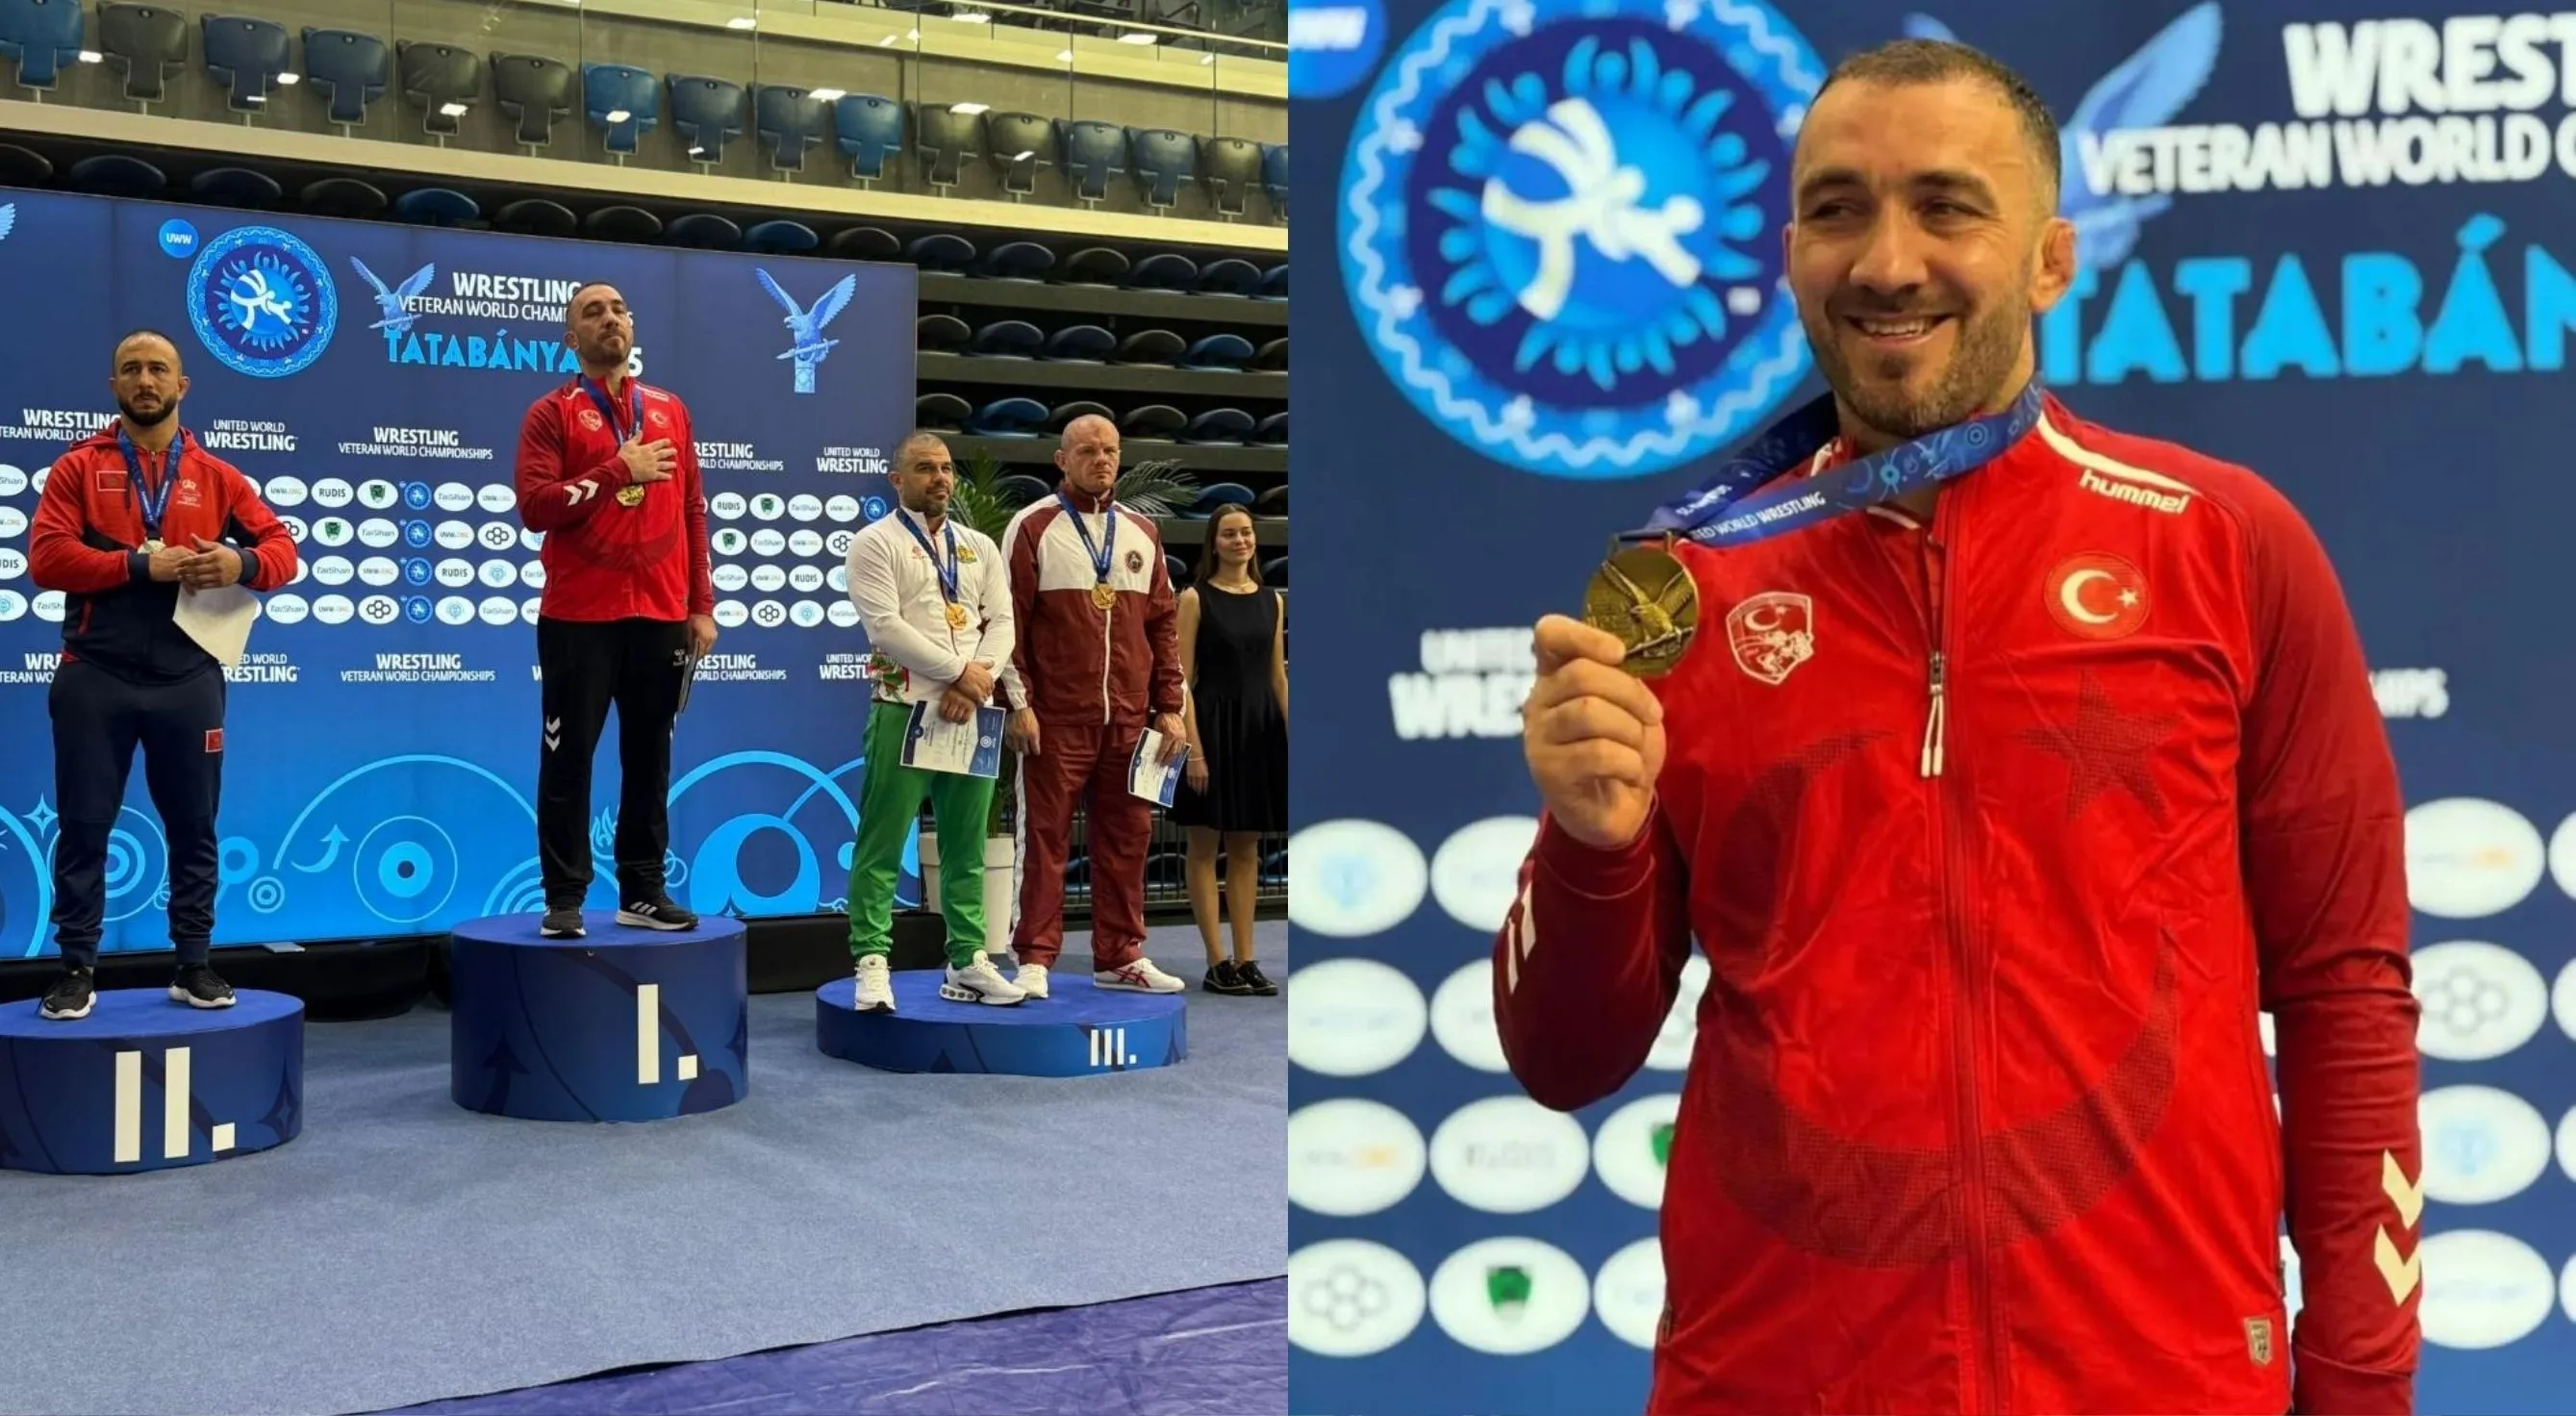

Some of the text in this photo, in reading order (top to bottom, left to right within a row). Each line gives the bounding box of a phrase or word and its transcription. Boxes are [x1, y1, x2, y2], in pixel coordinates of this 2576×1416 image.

[2078, 119, 2332, 195] VETERAN
[2334, 114, 2552, 188] WORLD
[166, 232, 192, 245] UWW
[398, 294, 568, 323] VETERAN WORLD CHAM
[383, 328, 582, 374] TATABÁNYA
[33, 427, 74, 442] WORLD
[214, 418, 285, 434] UNITED WORLD
[204, 431, 295, 451] WRESTLING
[373, 426, 460, 446] WRESTLING
[338, 442, 493, 460] VETERAN WORLD CHAMPIONSHIPS
[694, 442, 754, 459] RESTLING
[823, 446, 880, 458] UNITED WORLD
[717, 458, 784, 471] CHAMPIONSHIPS
[816, 456, 888, 474] WRESTLING
[318, 487, 346, 497] RUDIS
[2079, 468, 2190, 515] hummel
[717, 500, 741, 511] RUDIS
[1714, 514, 1759, 535] WORLD
[1756, 491, 1827, 524] WRESTLING
[441, 568, 468, 578] RUDIS
[795, 573, 818, 583] RUDIS
[252, 653, 288, 665] WORLD
[376, 653, 461, 670] WRESTLING
[825, 653, 854, 664] UNITED
[221, 666, 298, 683] RESTLING
[340, 670, 496, 682] VETERAN WORLD CHAMPIONSHIPS
[720, 669, 787, 681] CHAMPIONSHIPS
[638, 983, 698, 1084] I.
[1090, 1027, 1137, 1067] III.
[114, 1046, 236, 1163] II.
